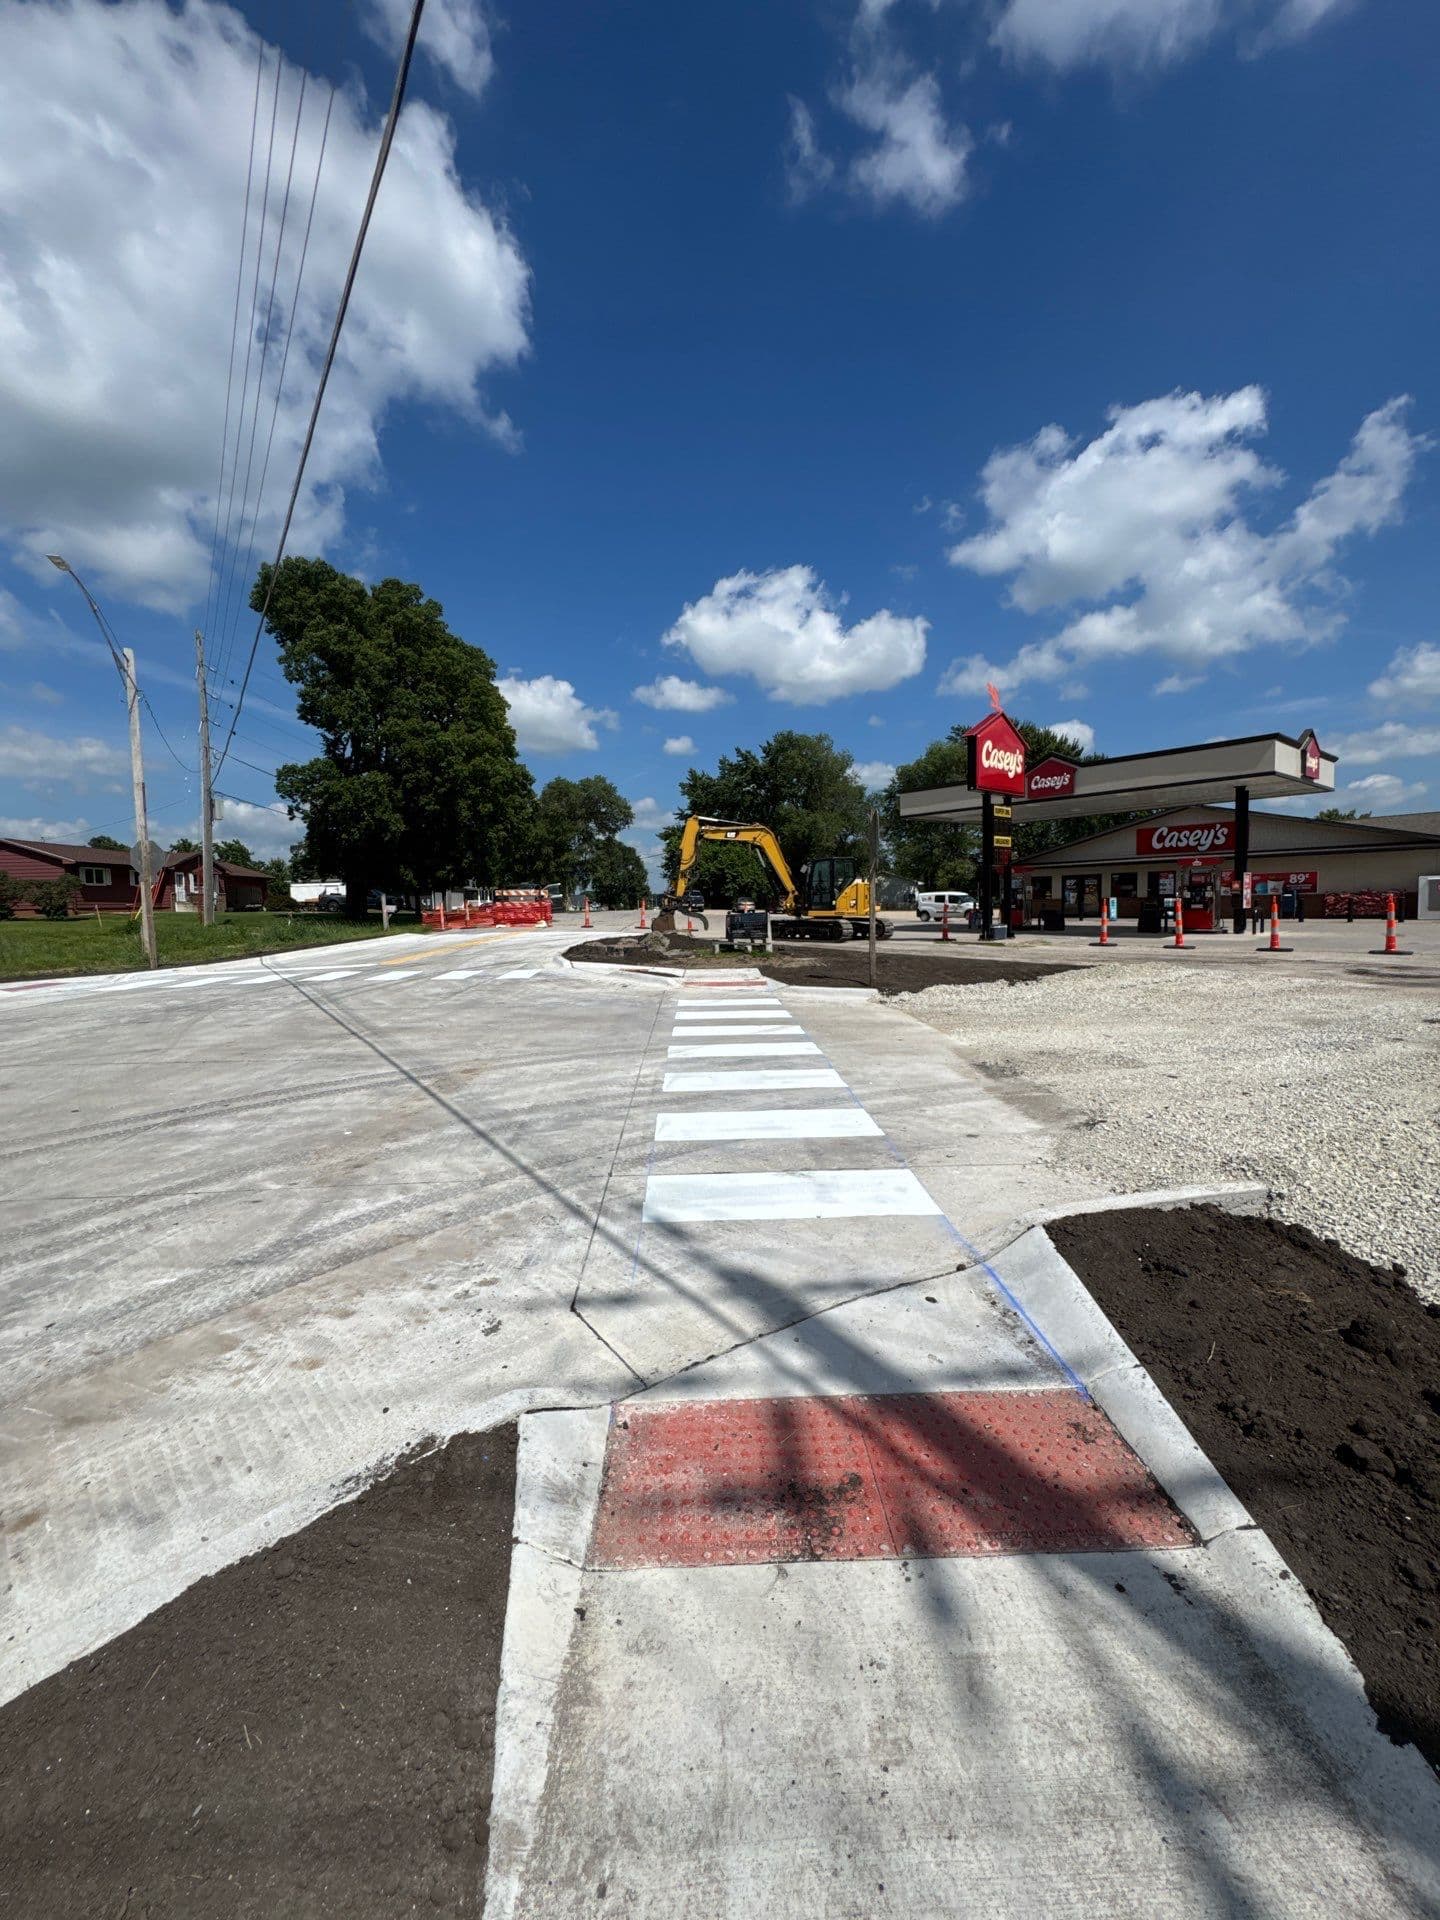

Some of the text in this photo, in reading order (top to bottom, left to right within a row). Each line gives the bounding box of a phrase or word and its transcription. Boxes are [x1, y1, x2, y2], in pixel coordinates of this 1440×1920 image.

[982, 740, 1023, 778] Casey's
[1031, 772, 1070, 790] Casey's
[1152, 824, 1228, 851] Casey's
